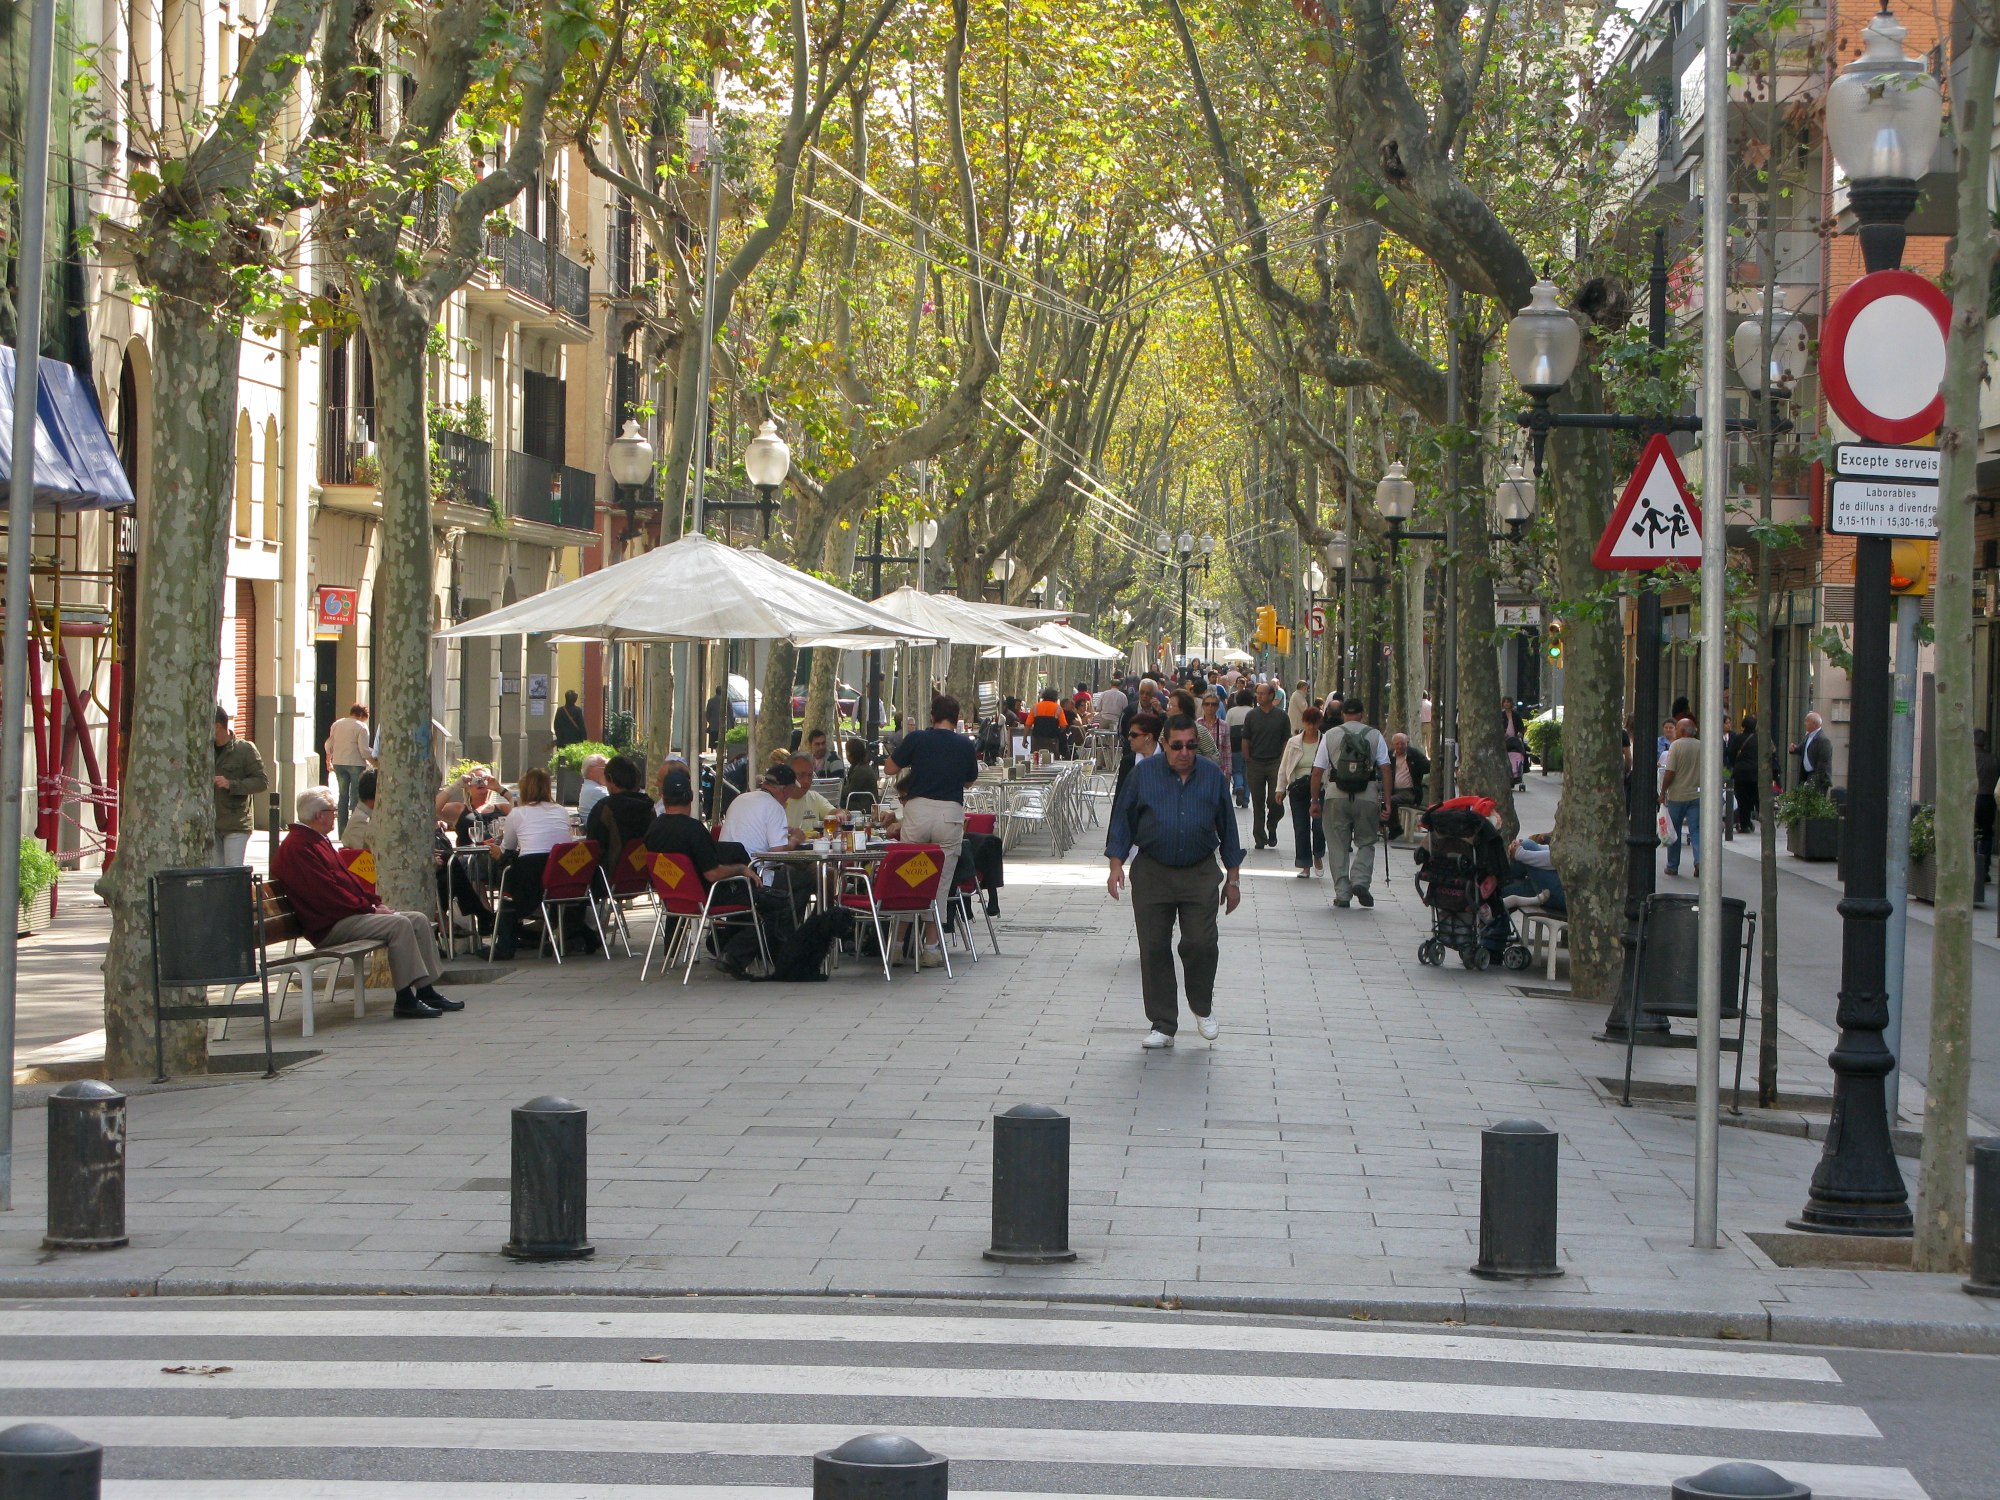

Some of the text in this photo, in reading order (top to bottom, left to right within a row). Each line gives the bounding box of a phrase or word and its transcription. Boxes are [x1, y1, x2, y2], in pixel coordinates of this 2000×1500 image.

[1841, 452, 1938, 470] Excepte serveis
[1866, 487, 1917, 498] Laborables
[1839, 501, 1850, 511] de
[1854, 502, 1885, 512] dilluns
[1837, 515, 1876, 526] 9,15-11h
